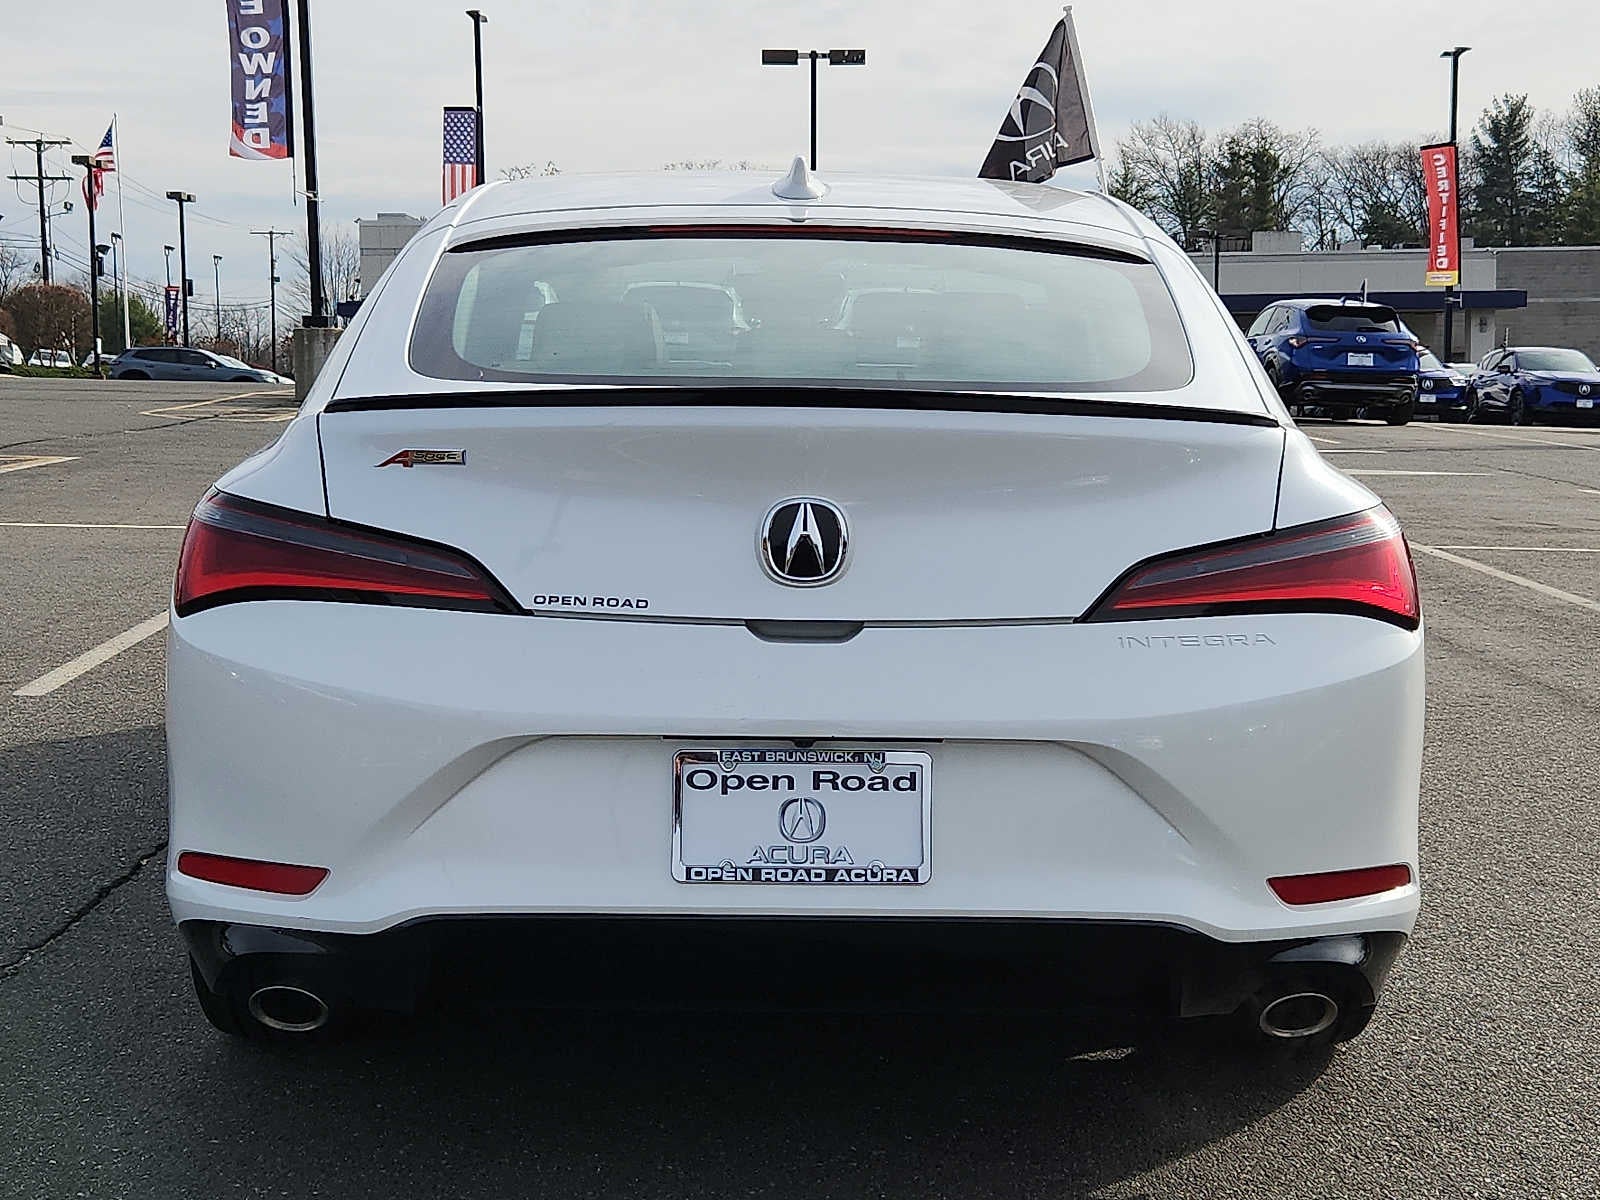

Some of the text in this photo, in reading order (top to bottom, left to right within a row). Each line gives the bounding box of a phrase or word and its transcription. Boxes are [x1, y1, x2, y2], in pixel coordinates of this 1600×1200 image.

[533, 595, 649, 609] OPEN ROAD
[1117, 632, 1277, 649] INTEGRA
[722, 751, 761, 763] EAST
[863, 752, 884, 763] NJ
[685, 769, 917, 795] Open Road
[746, 845, 854, 864] ACURA
[690, 867, 915, 882] OPEN ROAD ACURA
